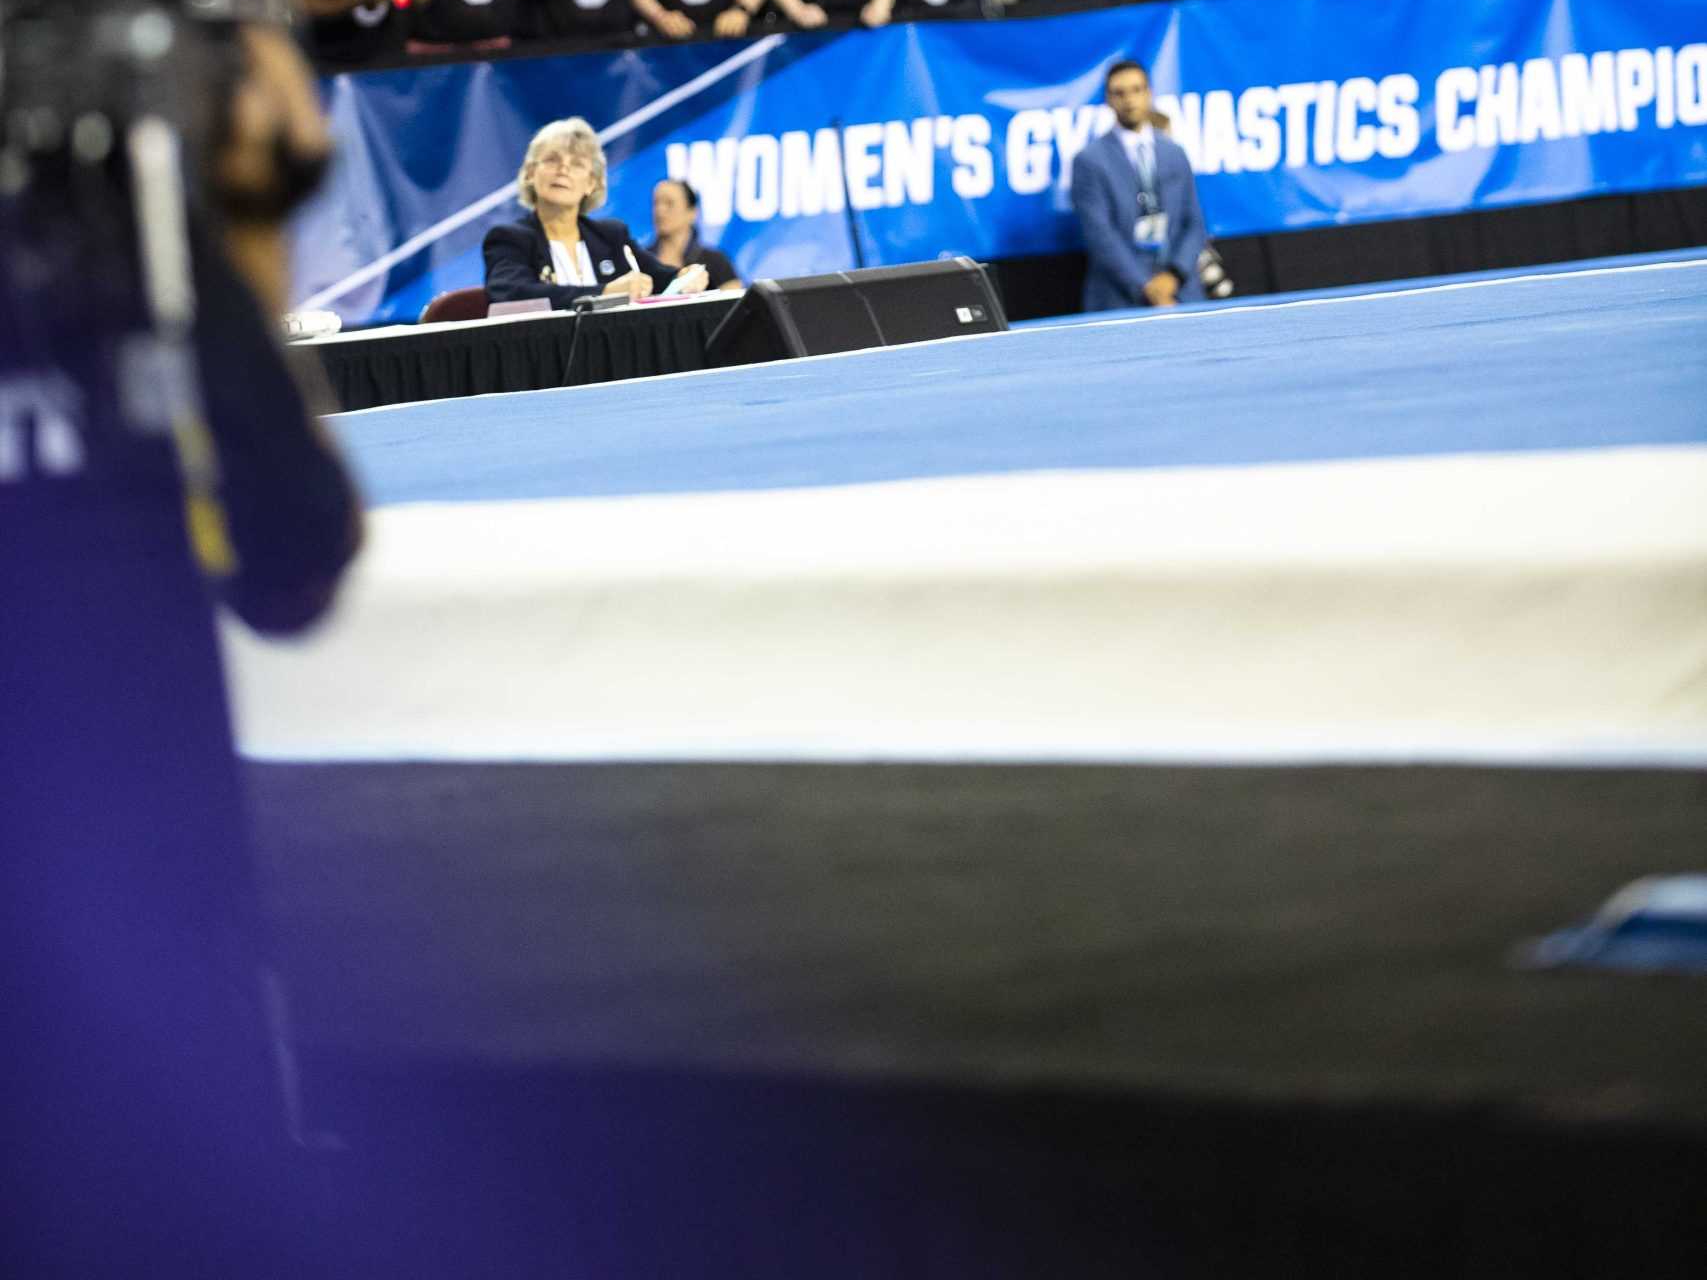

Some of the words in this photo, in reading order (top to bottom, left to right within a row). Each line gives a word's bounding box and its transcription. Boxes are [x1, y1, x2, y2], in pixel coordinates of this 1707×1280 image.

[664, 113, 995, 228] WOMEN'S
[1005, 73, 1421, 196] GYNASTICS
[1435, 42, 1707, 153] CHAMPIO
